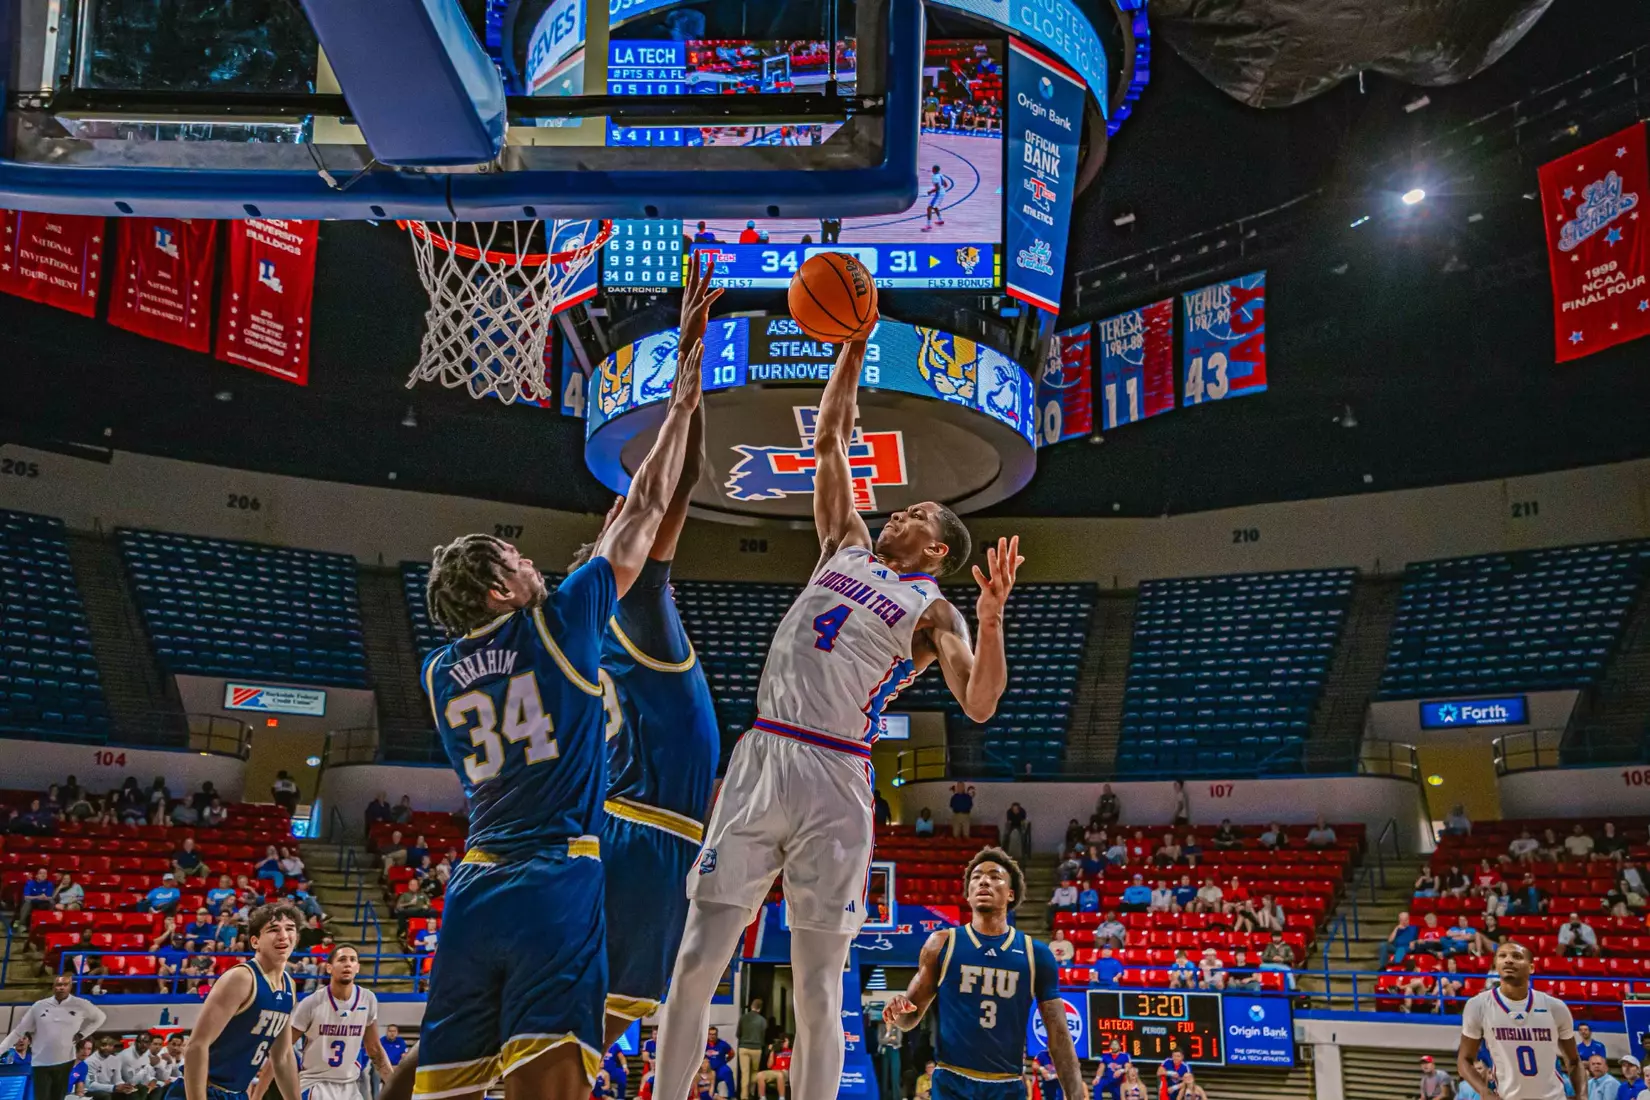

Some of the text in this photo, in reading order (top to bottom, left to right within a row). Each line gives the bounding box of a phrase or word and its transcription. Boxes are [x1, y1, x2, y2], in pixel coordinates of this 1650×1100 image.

[1021, 6, 1071, 54] CLOSE
[615, 48, 676, 63] LA TECH
[647, 70, 654, 78] R
[660, 70, 667, 78] A
[671, 70, 684, 78] FL
[613, 84, 680, 94] 0 5 1 0 1
[1017, 92, 1071, 131] Origin Bank
[612, 130, 680, 140] 5 4 1 1 1
[1025, 129, 1060, 158] OFFICIAL
[1024, 142, 1060, 178] BANK
[1023, 204, 1054, 226] ATHLETICS
[244, 218, 304, 245] UNIVERSITY
[627, 225, 633, 235] 1
[644, 225, 650, 235] 1
[658, 225, 664, 235] 1
[672, 225, 678, 235] 1
[246, 228, 301, 255] BULLDOGS
[610, 241, 680, 251] 6 3 0 0 0
[610, 256, 677, 266] 9 9 4 1 1
[761, 250, 798, 273] 34
[890, 251, 918, 272] 31
[1585, 260, 1618, 280] 1999
[20, 266, 78, 291] TOURAMENT
[604, 271, 679, 281] 34 0 0 0 2
[728, 280, 745, 288] FLS
[929, 280, 946, 288] FLS
[948, 280, 954, 288] 9
[957, 280, 991, 288] BONUS
[1582, 271, 1626, 294] NCAA
[1186, 283, 1231, 317] VENUS
[1562, 274, 1646, 312] FINAL FOUR
[723, 322, 737, 340] 7
[1100, 309, 1144, 342] TERESA
[721, 342, 880, 362] 4 STEALS 3
[1185, 352, 1228, 404] 43
[1229, 286, 1267, 391] LACY
[713, 364, 880, 385] 10 TURNOVE 8
[1105, 377, 1139, 428] 11
[1, 458, 39, 478] 205
[227, 493, 261, 511] 206
[1511, 501, 1539, 518] 211
[494, 524, 524, 539] 207
[1233, 529, 1260, 544] 210
[814, 569, 877, 606] LOUISIANA
[866, 590, 907, 629] TECH
[813, 603, 853, 653] 4
[449, 649, 518, 689] IBRAHIM
[1461, 705, 1506, 720] Forth
[445, 671, 560, 785] 34
[94, 751, 126, 767] 104
[1621, 770, 1650, 786] 108
[1210, 784, 1234, 798] 107
[959, 964, 1020, 999] FIU
[979, 1000, 997, 1029] 3
[1138, 994, 1184, 1017] 3:20
[250, 1010, 290, 1038] FIU
[349, 1024, 363, 1037] TECH
[1035, 1019, 1080, 1031] PSI
[1142, 1026, 1167, 1035] PERIOD
[1177, 1021, 1195, 1033] FIU
[1229, 1025, 1287, 1039] Origin Bank
[1532, 1027, 1552, 1042] TECH
[327, 1040, 346, 1068] 3
[1156, 1037, 1161, 1053] 1
[1190, 1035, 1219, 1058] 31
[1516, 1046, 1538, 1077] 0
